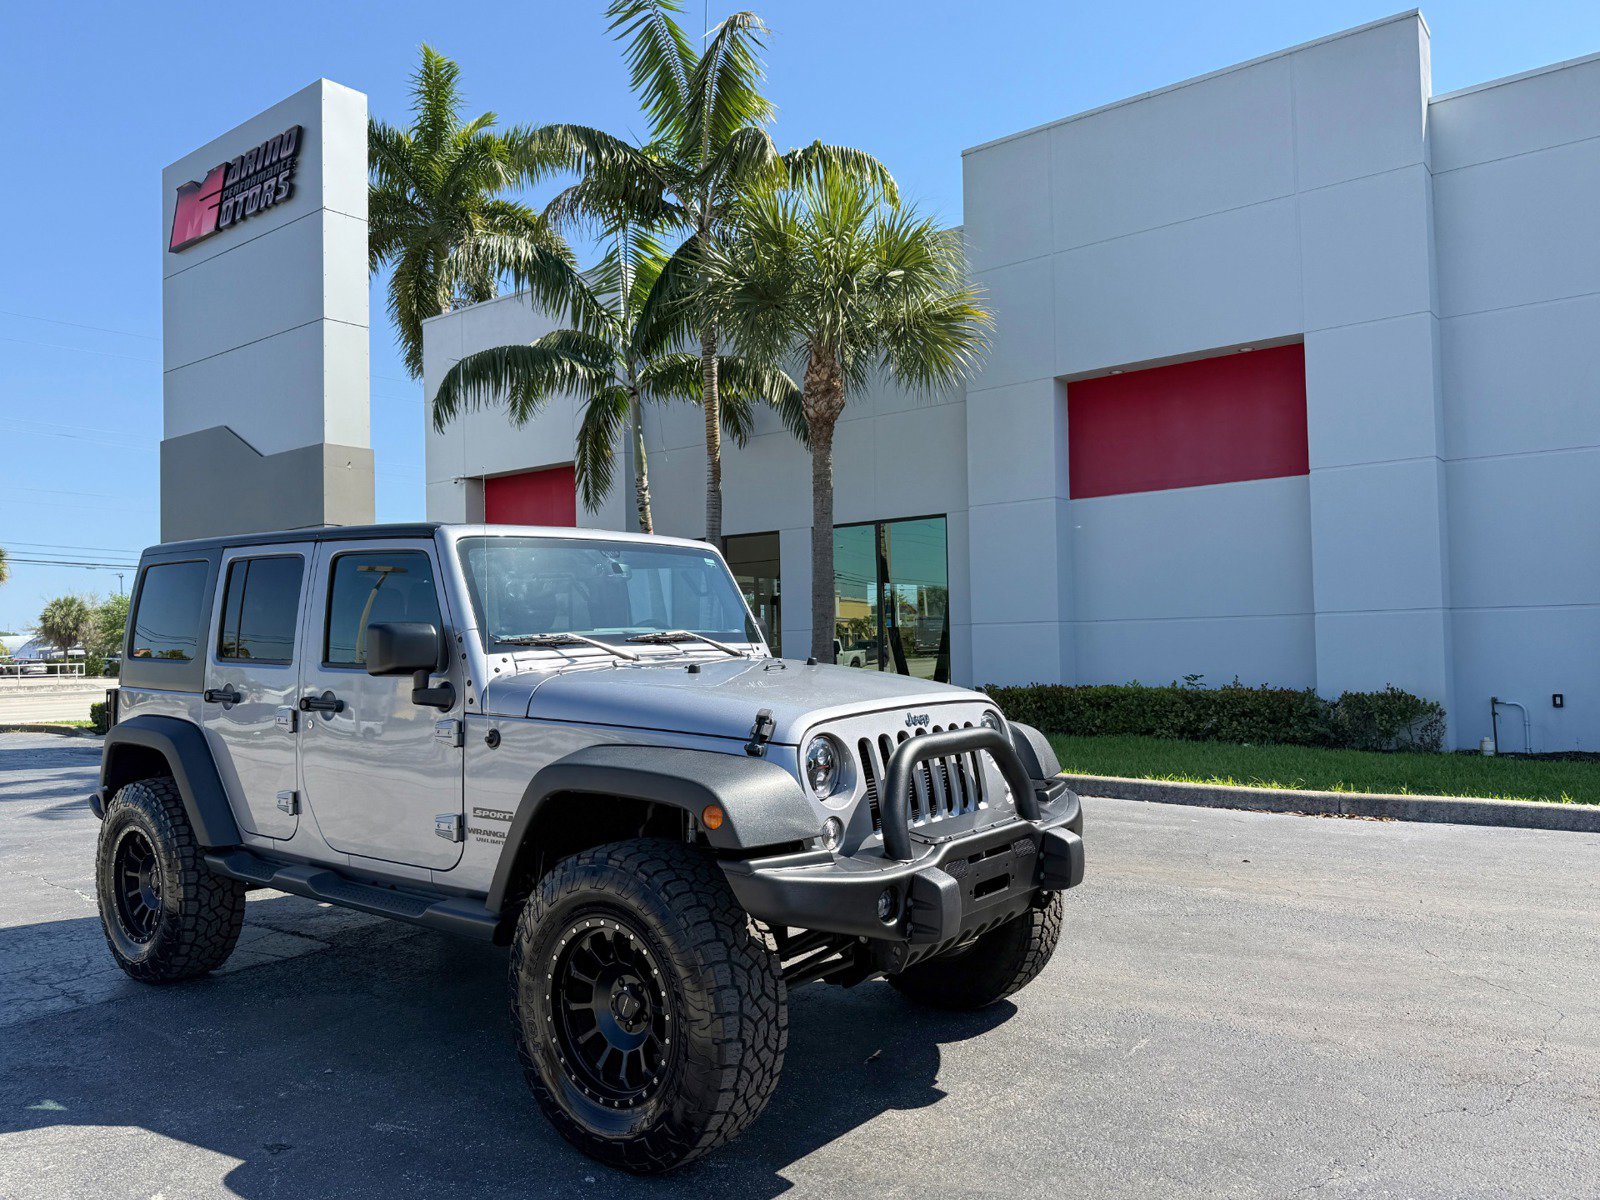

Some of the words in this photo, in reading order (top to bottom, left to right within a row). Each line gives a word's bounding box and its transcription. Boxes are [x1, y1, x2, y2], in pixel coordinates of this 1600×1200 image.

[905, 712, 930, 727] Jeep
[474, 809, 514, 820] SPORT
[467, 828, 508, 839] WRANGL
